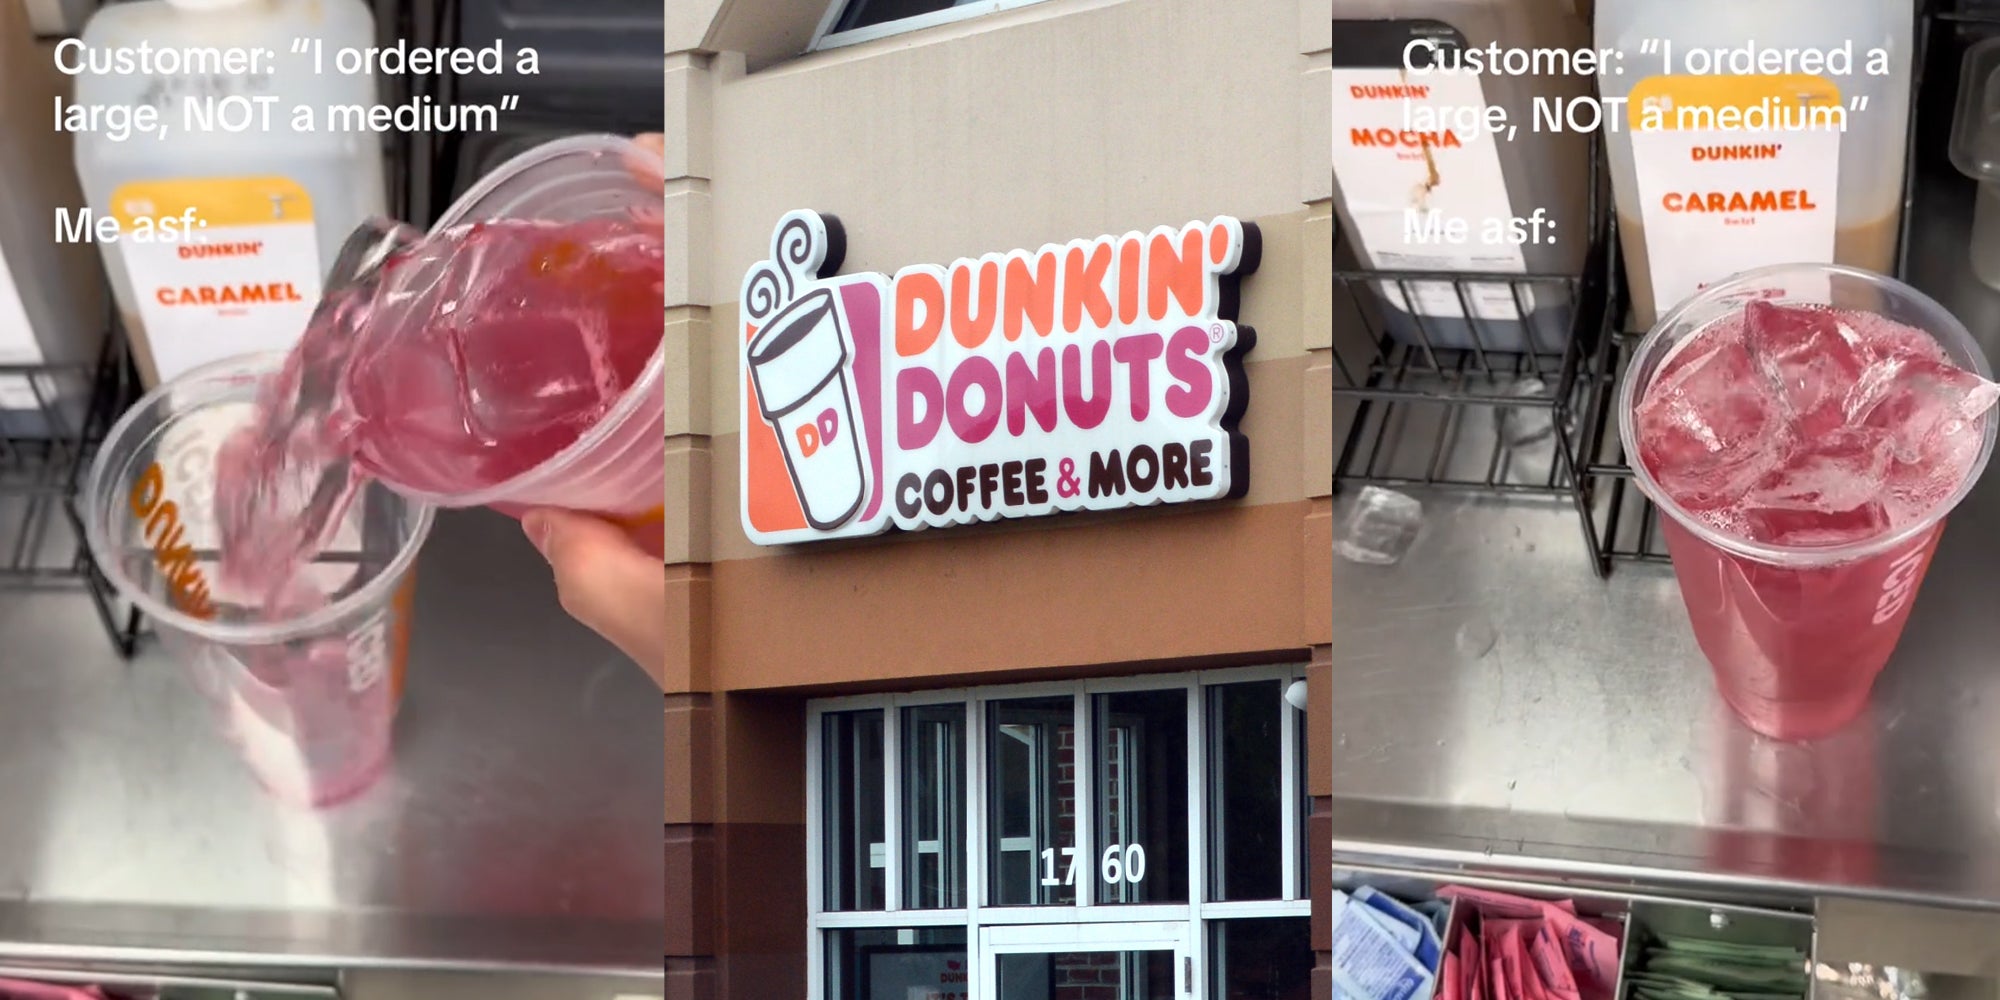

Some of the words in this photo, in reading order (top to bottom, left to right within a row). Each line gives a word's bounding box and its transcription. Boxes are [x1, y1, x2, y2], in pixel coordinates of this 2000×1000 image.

[1350, 84, 1430, 99] DUNKIN'
[1350, 128, 1462, 148] MOCHA
[1691, 143, 1782, 161] DUNKIN'
[1662, 189, 1817, 213] CARAMEL
[156, 282, 302, 306] CARAMEL
[894, 222, 1229, 357] DUNKIN'
[795, 407, 839, 459] DD
[895, 457, 1047, 519] COFFEE
[1056, 456, 1081, 499] &
[1088, 438, 1214, 500] MORE
